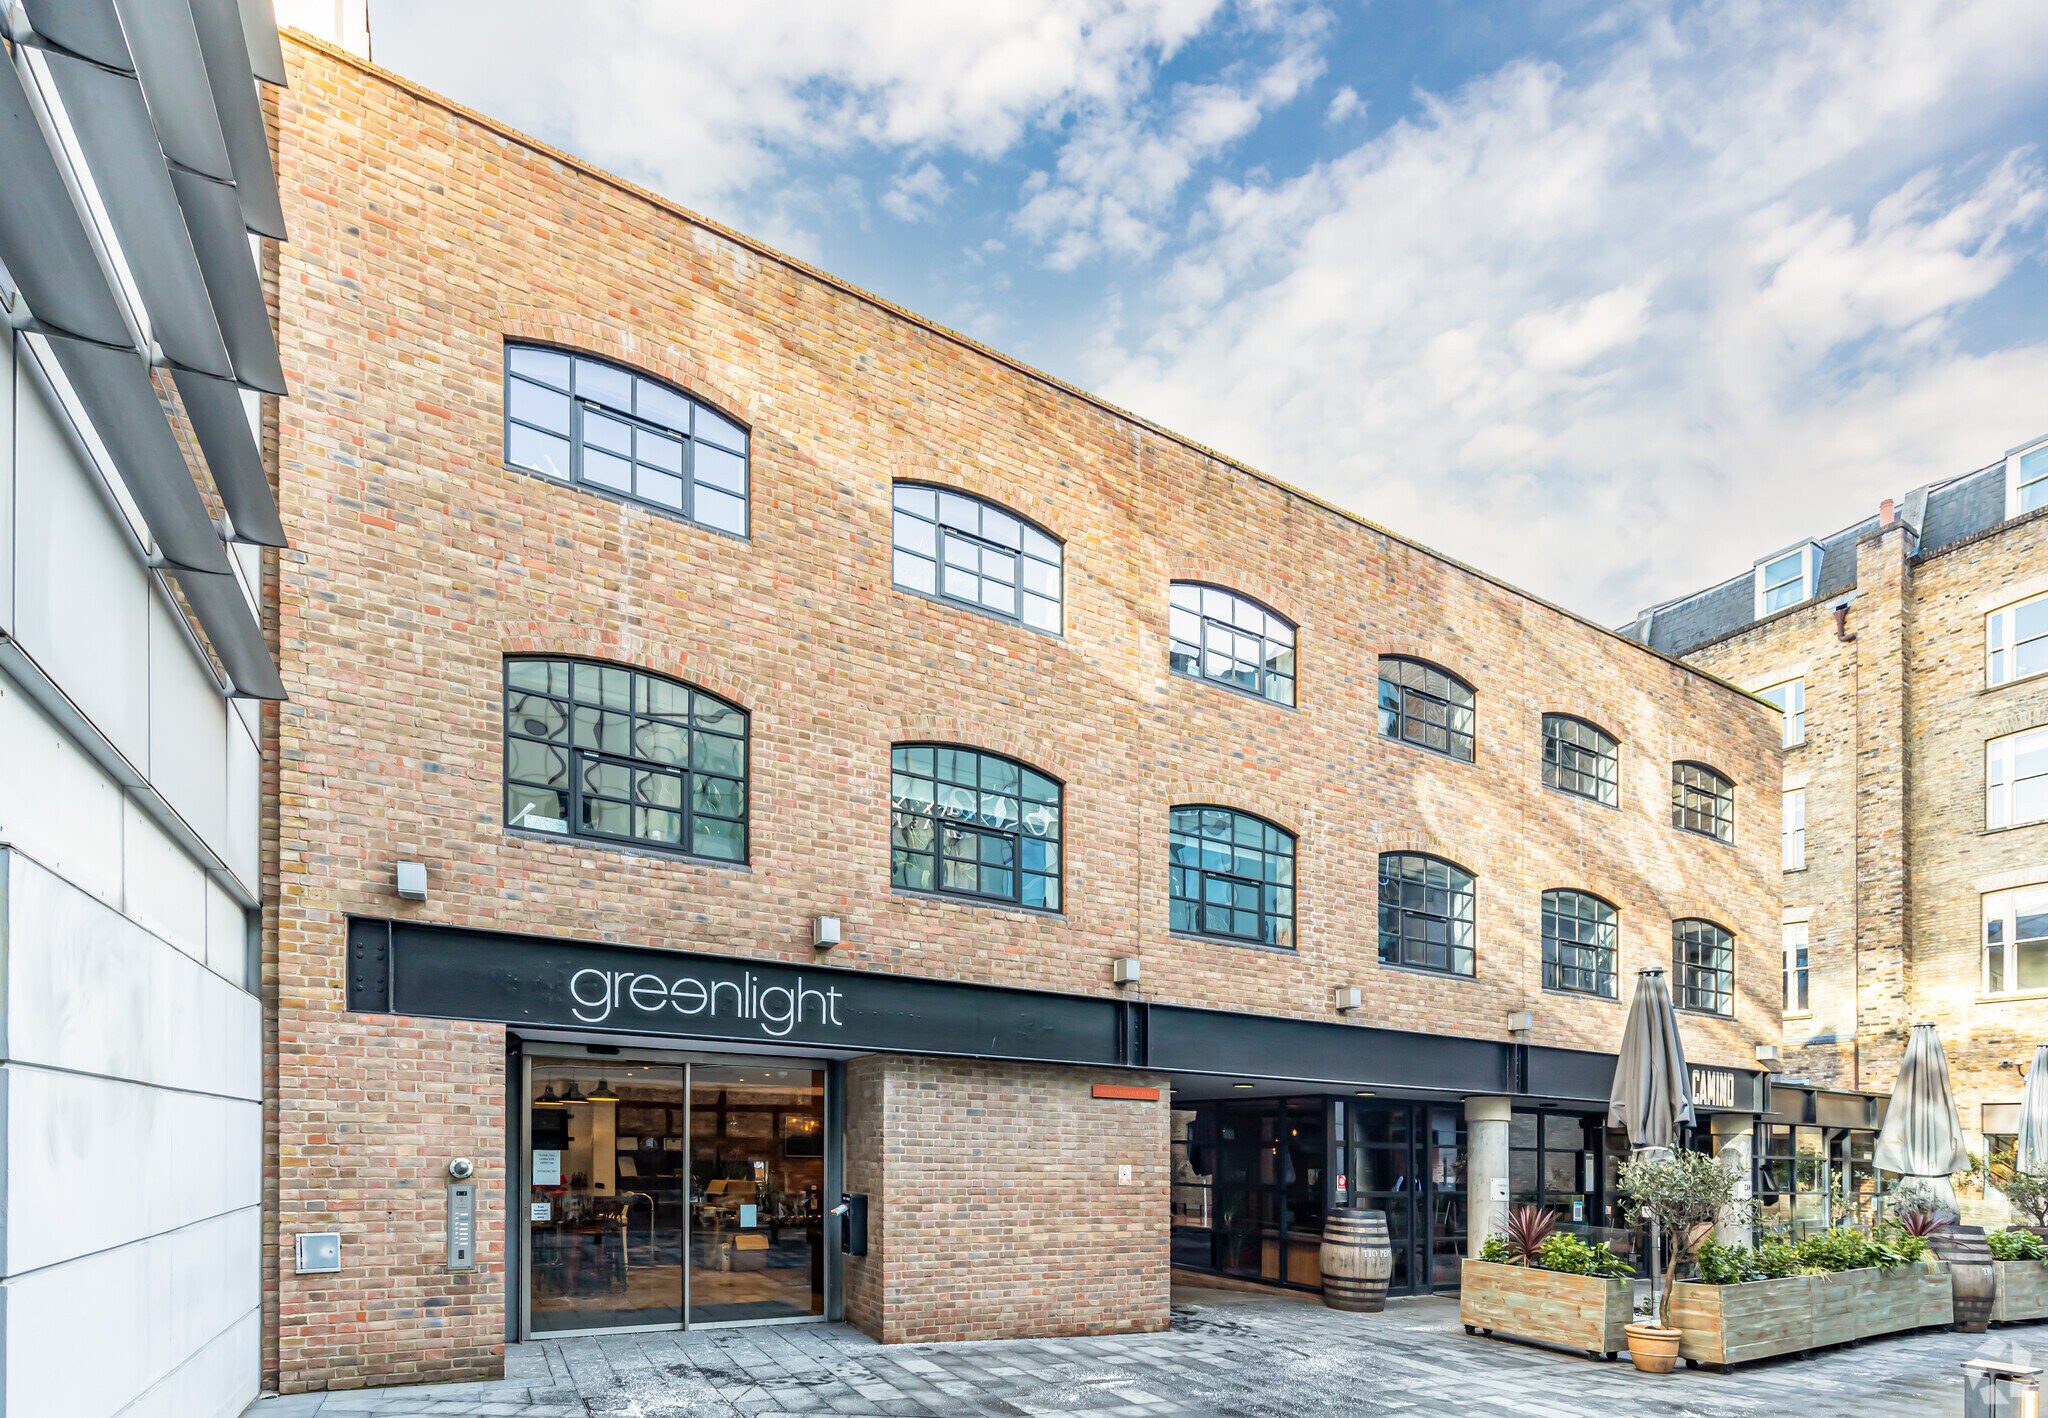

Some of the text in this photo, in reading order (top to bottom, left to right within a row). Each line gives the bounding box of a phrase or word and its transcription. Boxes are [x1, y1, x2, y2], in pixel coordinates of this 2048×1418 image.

[570, 968, 843, 1036] greenlight
[1692, 1069, 1734, 1107] CAMINO
[1362, 1249, 1377, 1257] TIO
